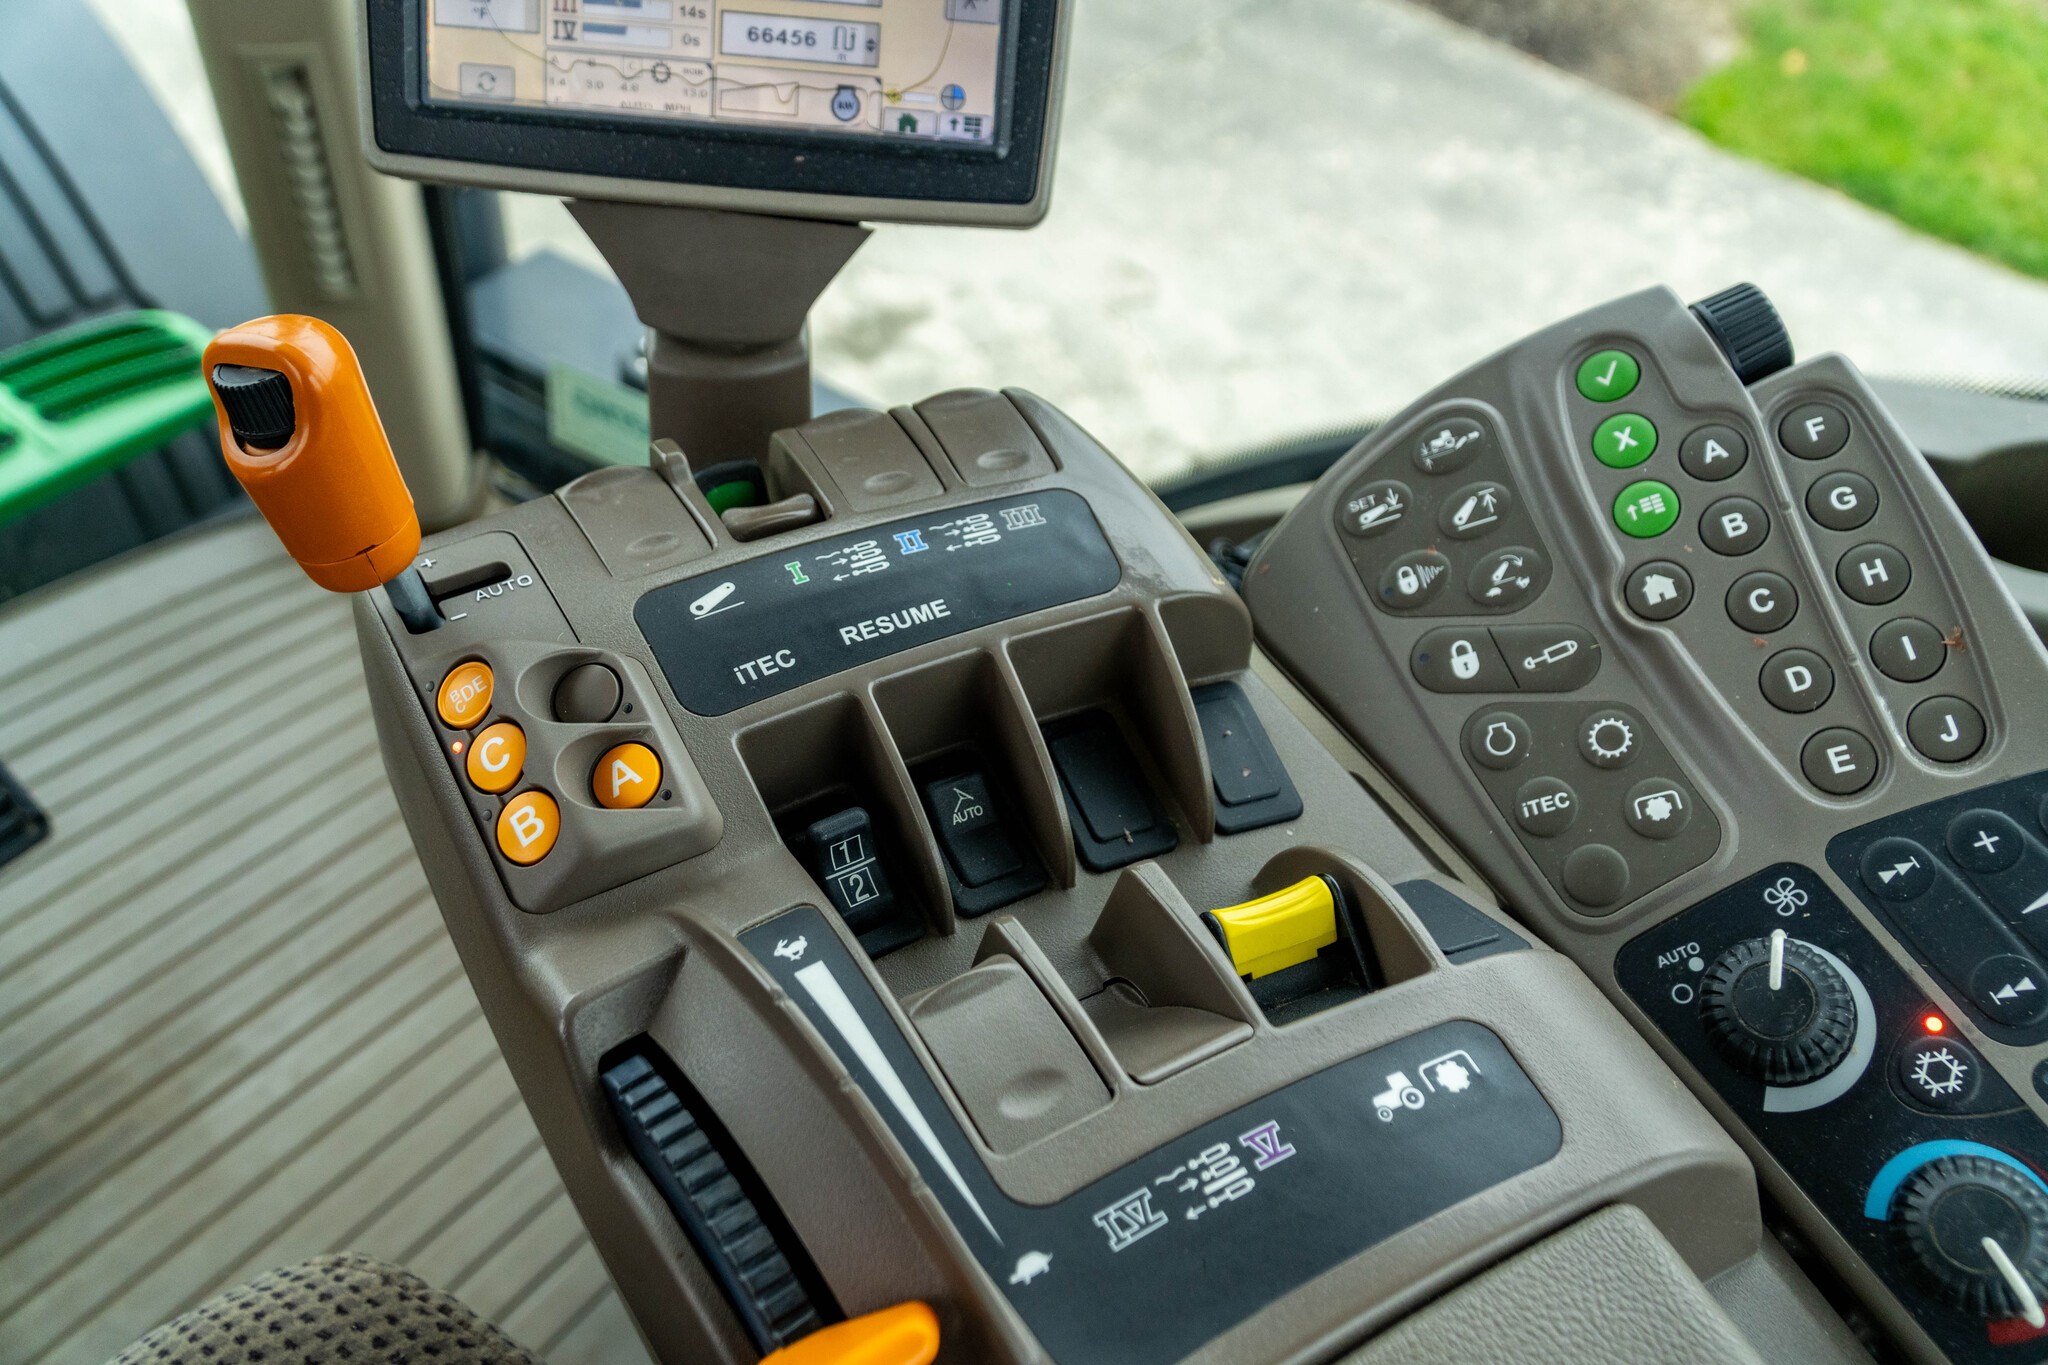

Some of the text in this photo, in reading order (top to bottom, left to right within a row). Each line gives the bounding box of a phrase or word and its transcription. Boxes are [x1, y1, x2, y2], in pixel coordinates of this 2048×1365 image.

[553, 20, 578, 41] IV
[682, 33, 700, 47] 0s
[747, 26, 817, 47] 66456
[1805, 416, 1826, 442] F
[1703, 439, 1729, 464] A
[1349, 493, 1377, 513] SET
[1830, 486, 1858, 511] G
[999, 503, 1047, 531] III
[1721, 512, 1748, 538] B
[893, 529, 930, 555] II
[784, 561, 811, 585] I
[1859, 558, 1889, 587] H
[475, 574, 533, 602] AUTO
[1749, 588, 1775, 613] C
[838, 598, 952, 646] RESUME
[1901, 635, 1917, 661] I
[733, 649, 797, 686] iTEC
[1784, 665, 1812, 693] D
[1940, 714, 1960, 742] J
[480, 736, 510, 772] C
[1826, 744, 1856, 774] E
[611, 758, 643, 798] A
[952, 804, 984, 826] AUTO
[1521, 791, 1570, 819] iTEC
[508, 805, 545, 848] B
[839, 841, 851, 864] 1
[849, 873, 870, 902] 2
[1658, 941, 1701, 969] AUTO
[1239, 1119, 1296, 1172] V
[1092, 1187, 1168, 1252] IV
